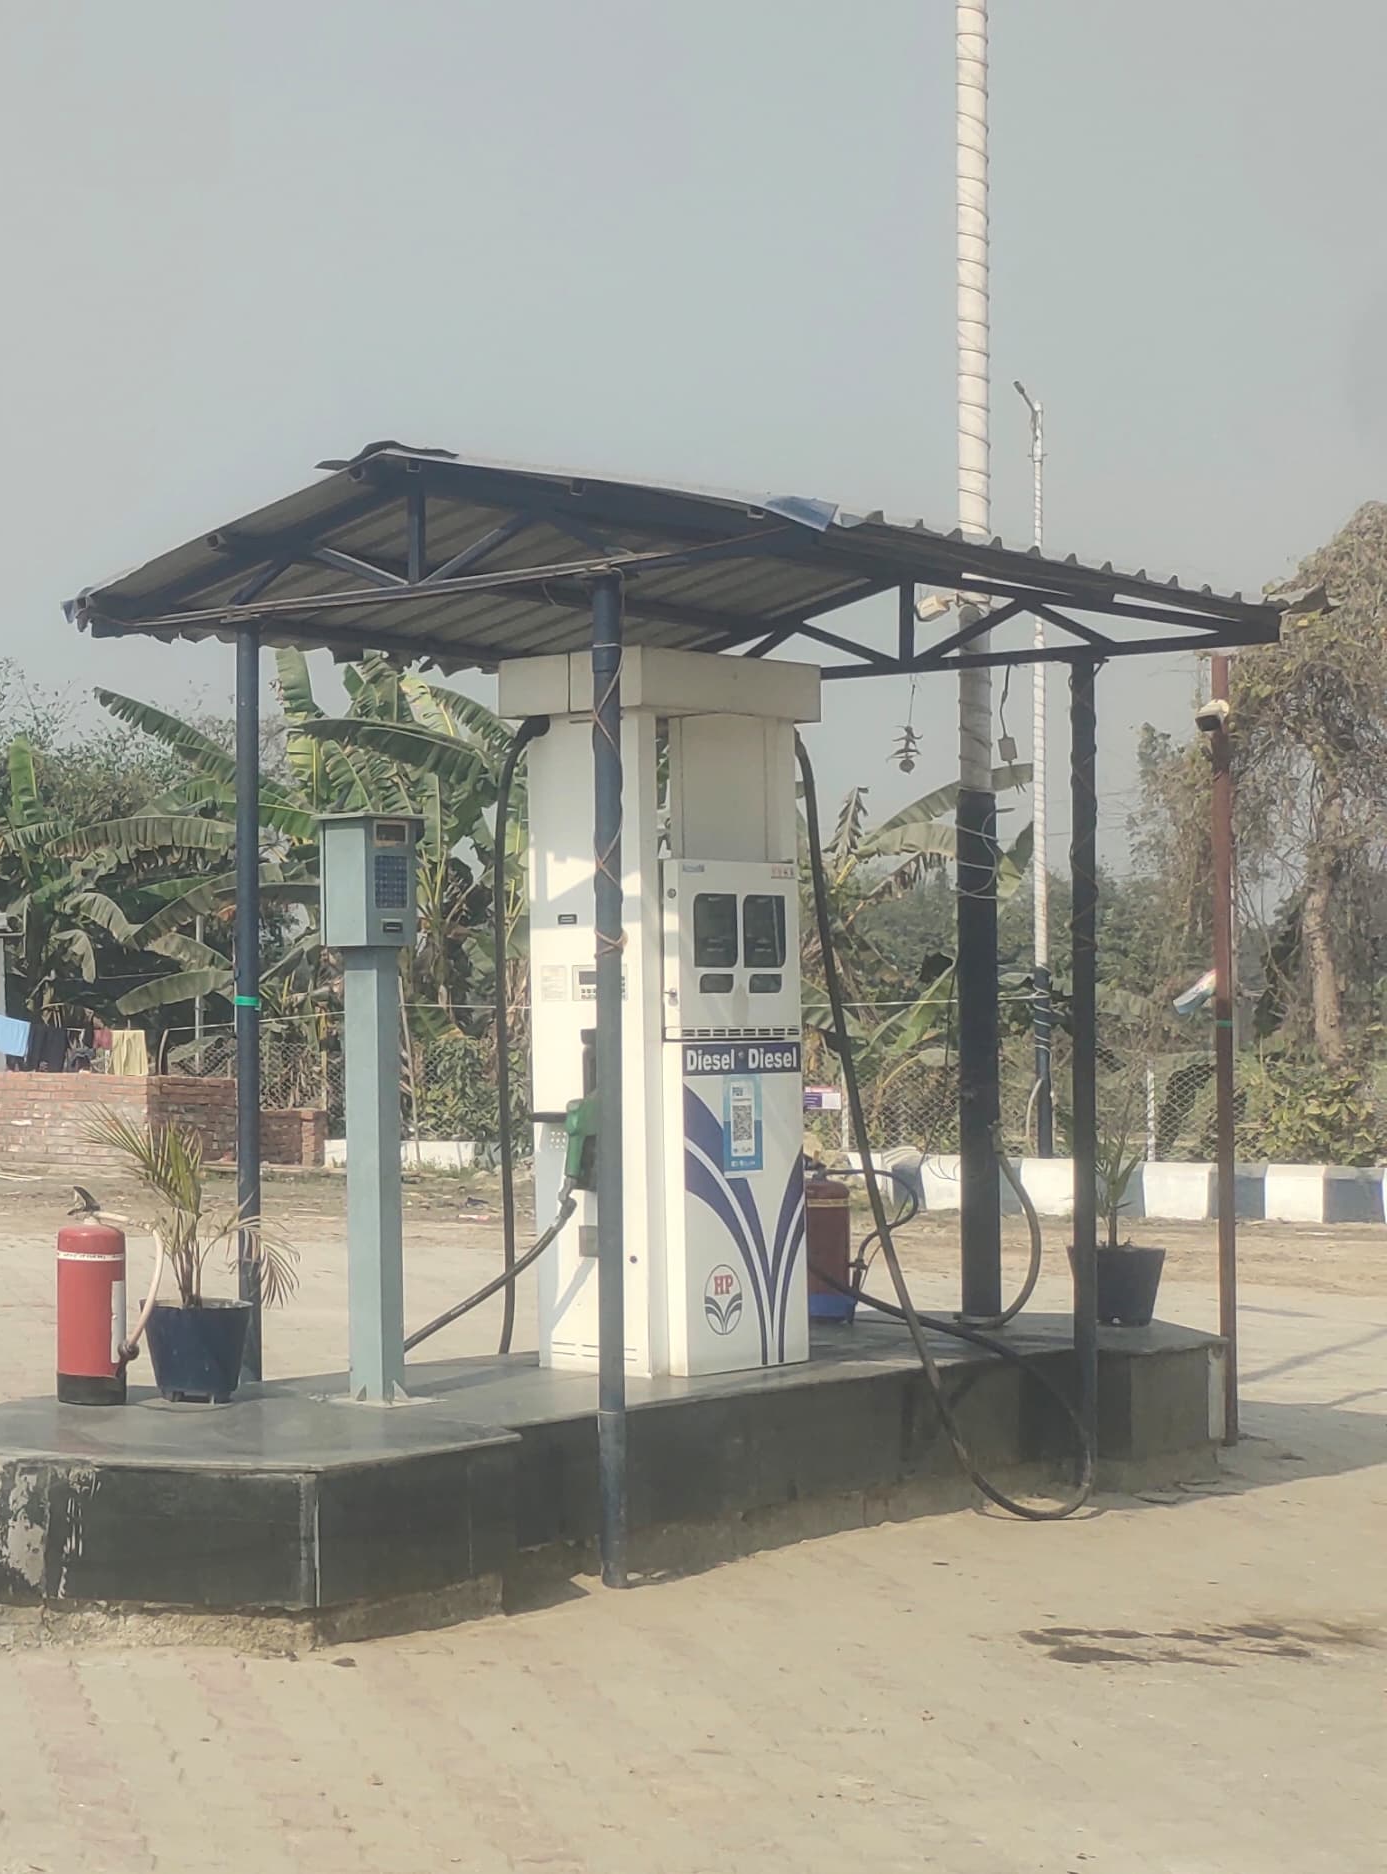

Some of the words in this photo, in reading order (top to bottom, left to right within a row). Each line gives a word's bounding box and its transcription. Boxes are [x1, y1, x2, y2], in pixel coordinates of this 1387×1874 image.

[686, 1049, 736, 1071] Diesel
[747, 1047, 797, 1069] Diesel
[713, 1274, 734, 1296] HP
